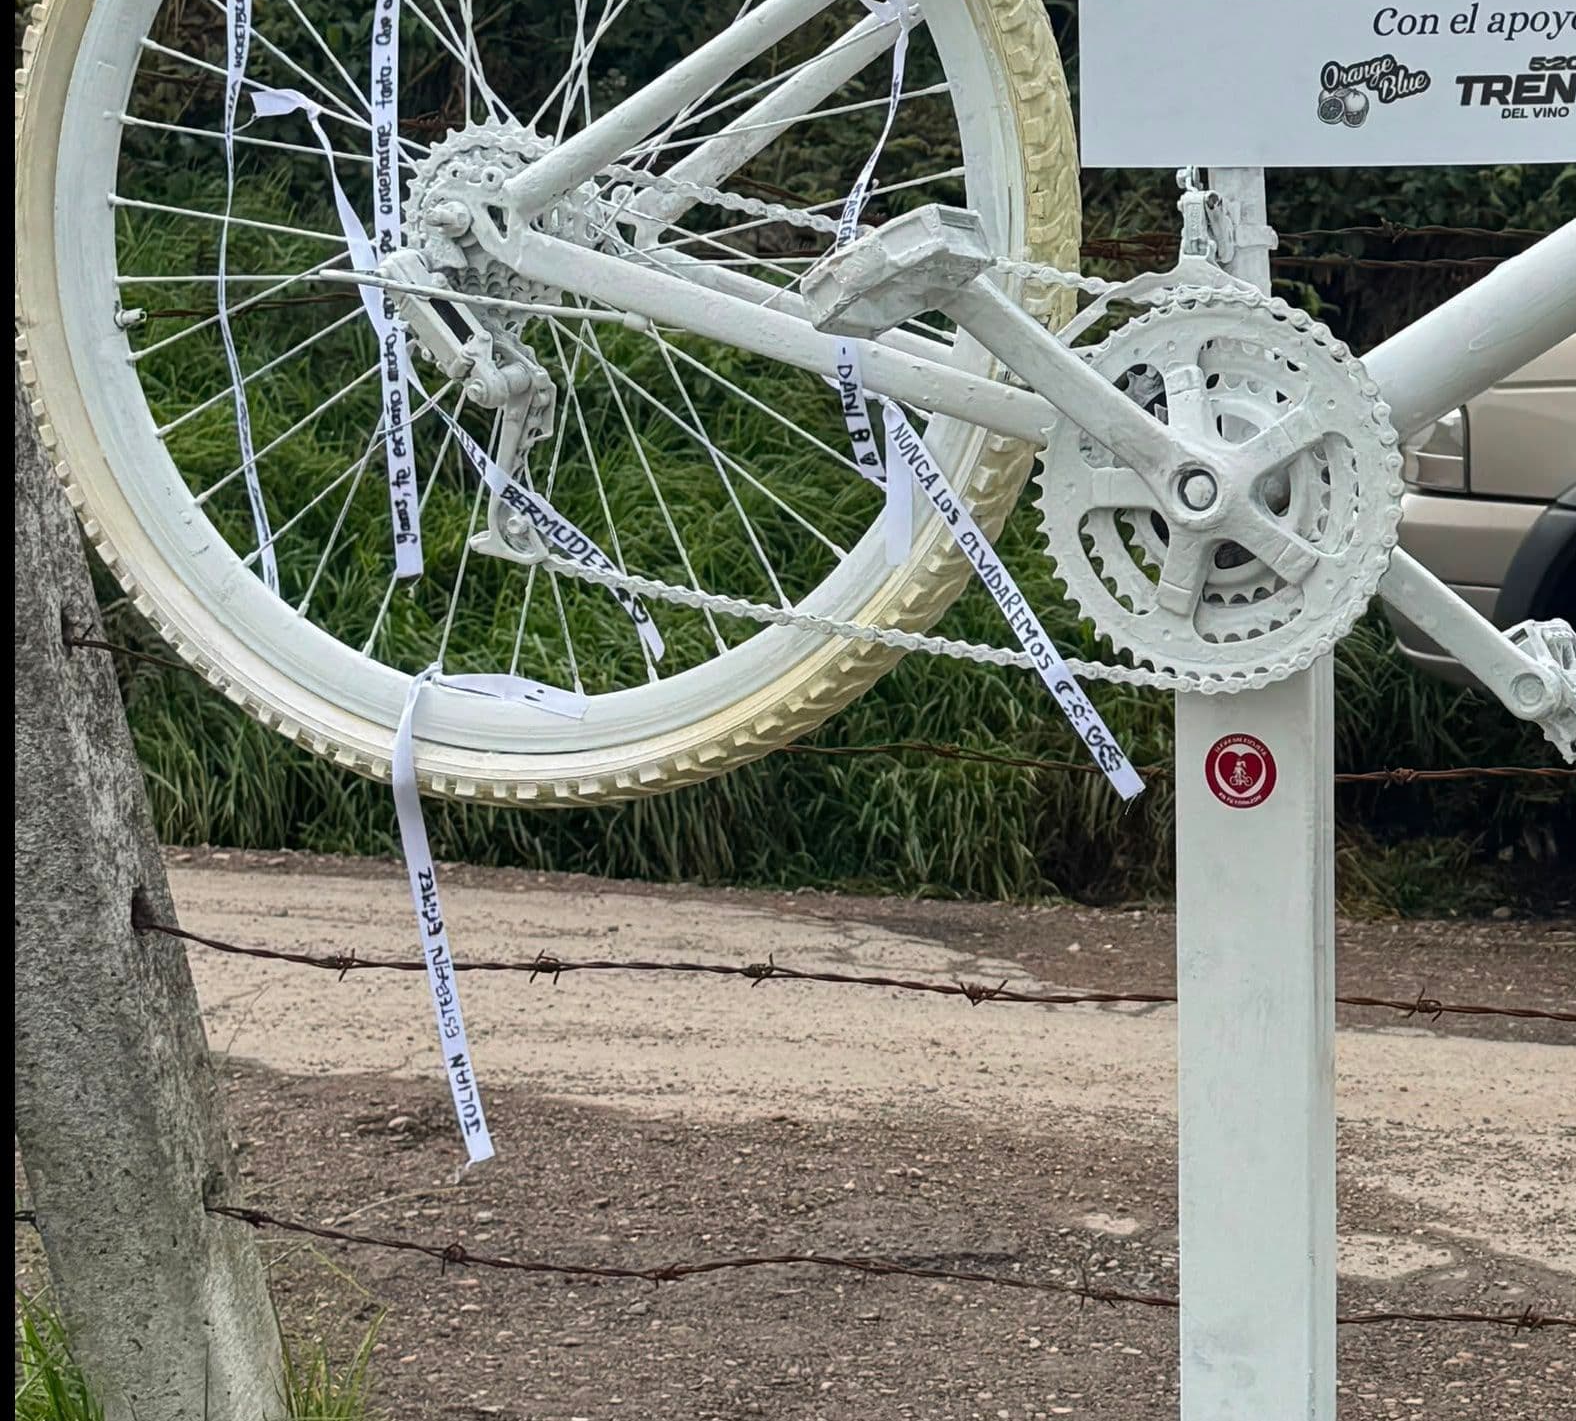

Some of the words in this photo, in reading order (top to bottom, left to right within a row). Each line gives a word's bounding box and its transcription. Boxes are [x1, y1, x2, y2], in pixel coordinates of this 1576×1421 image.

[1373, 7, 1440, 36] Con
[1449, 2, 1480, 35] el
[1322, 55, 1395, 89] Orange
[1379, 69, 1428, 100] Blue
[1501, 108, 1529, 120] DEL
[1533, 106, 1570, 119] VINO
[833, 361, 864, 420] DANI
[391, 468, 411, 492] te
[888, 421, 941, 490] NUNCA
[931, 488, 965, 527] LOS
[956, 526, 1060, 672] OLVIDAREMOS
[427, 945, 463, 1038] ESTEBAN
[448, 1051, 482, 1136] JULIAN
